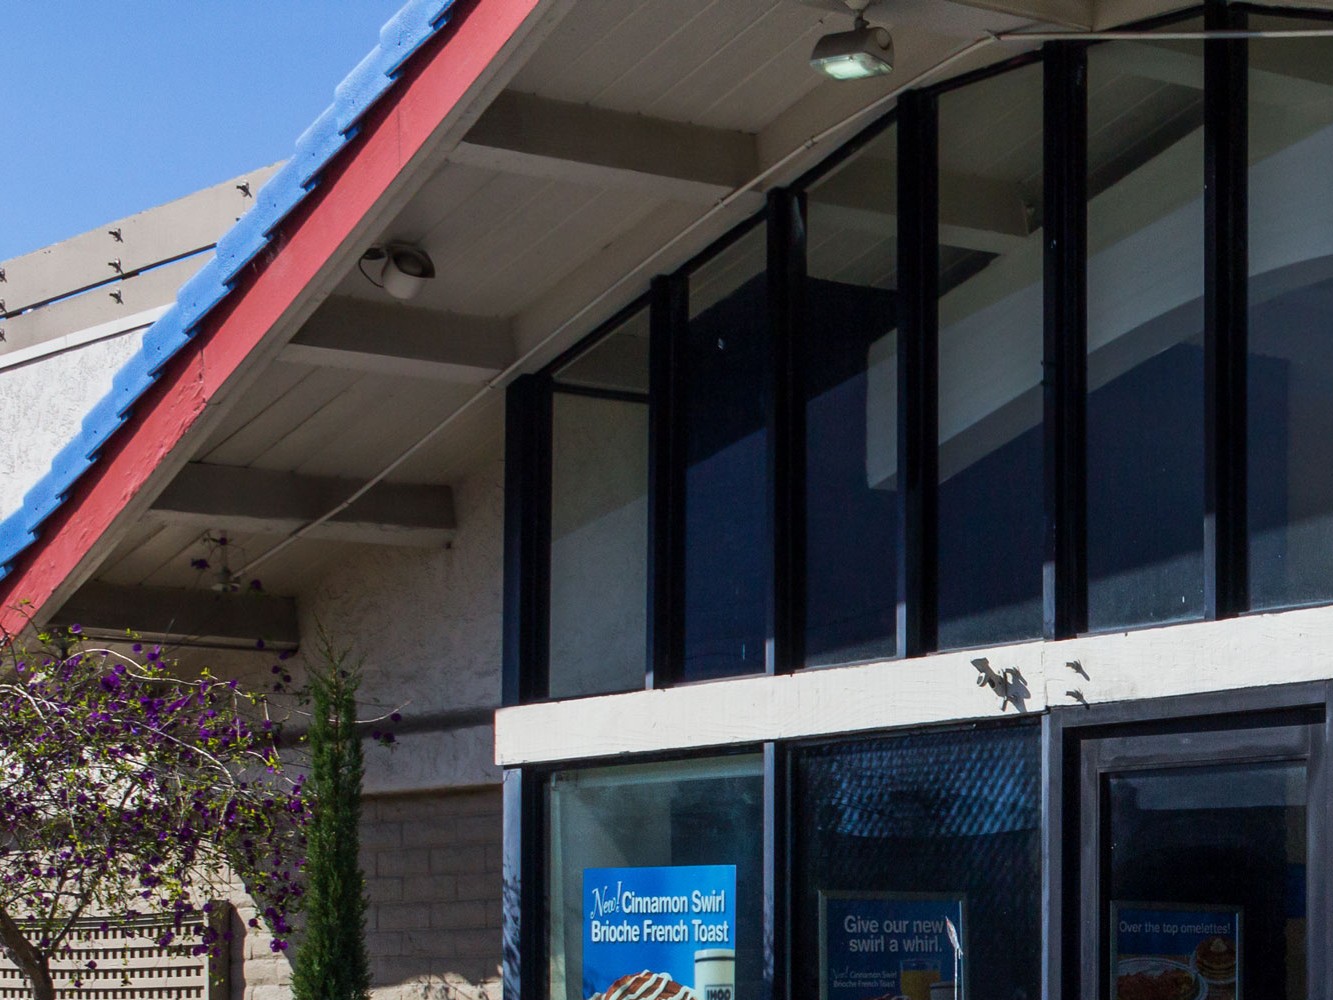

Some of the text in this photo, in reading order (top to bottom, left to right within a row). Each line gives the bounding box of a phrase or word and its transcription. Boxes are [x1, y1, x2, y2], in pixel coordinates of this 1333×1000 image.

[590, 881, 725, 919] New! Cinnamon Swirl
[591, 919, 729, 942] Brioche French Toast
[844, 915, 944, 934] Give our new
[1119, 920, 1231, 936] Over the top omelettes!
[849, 935, 943, 952] swirl a whirl.
